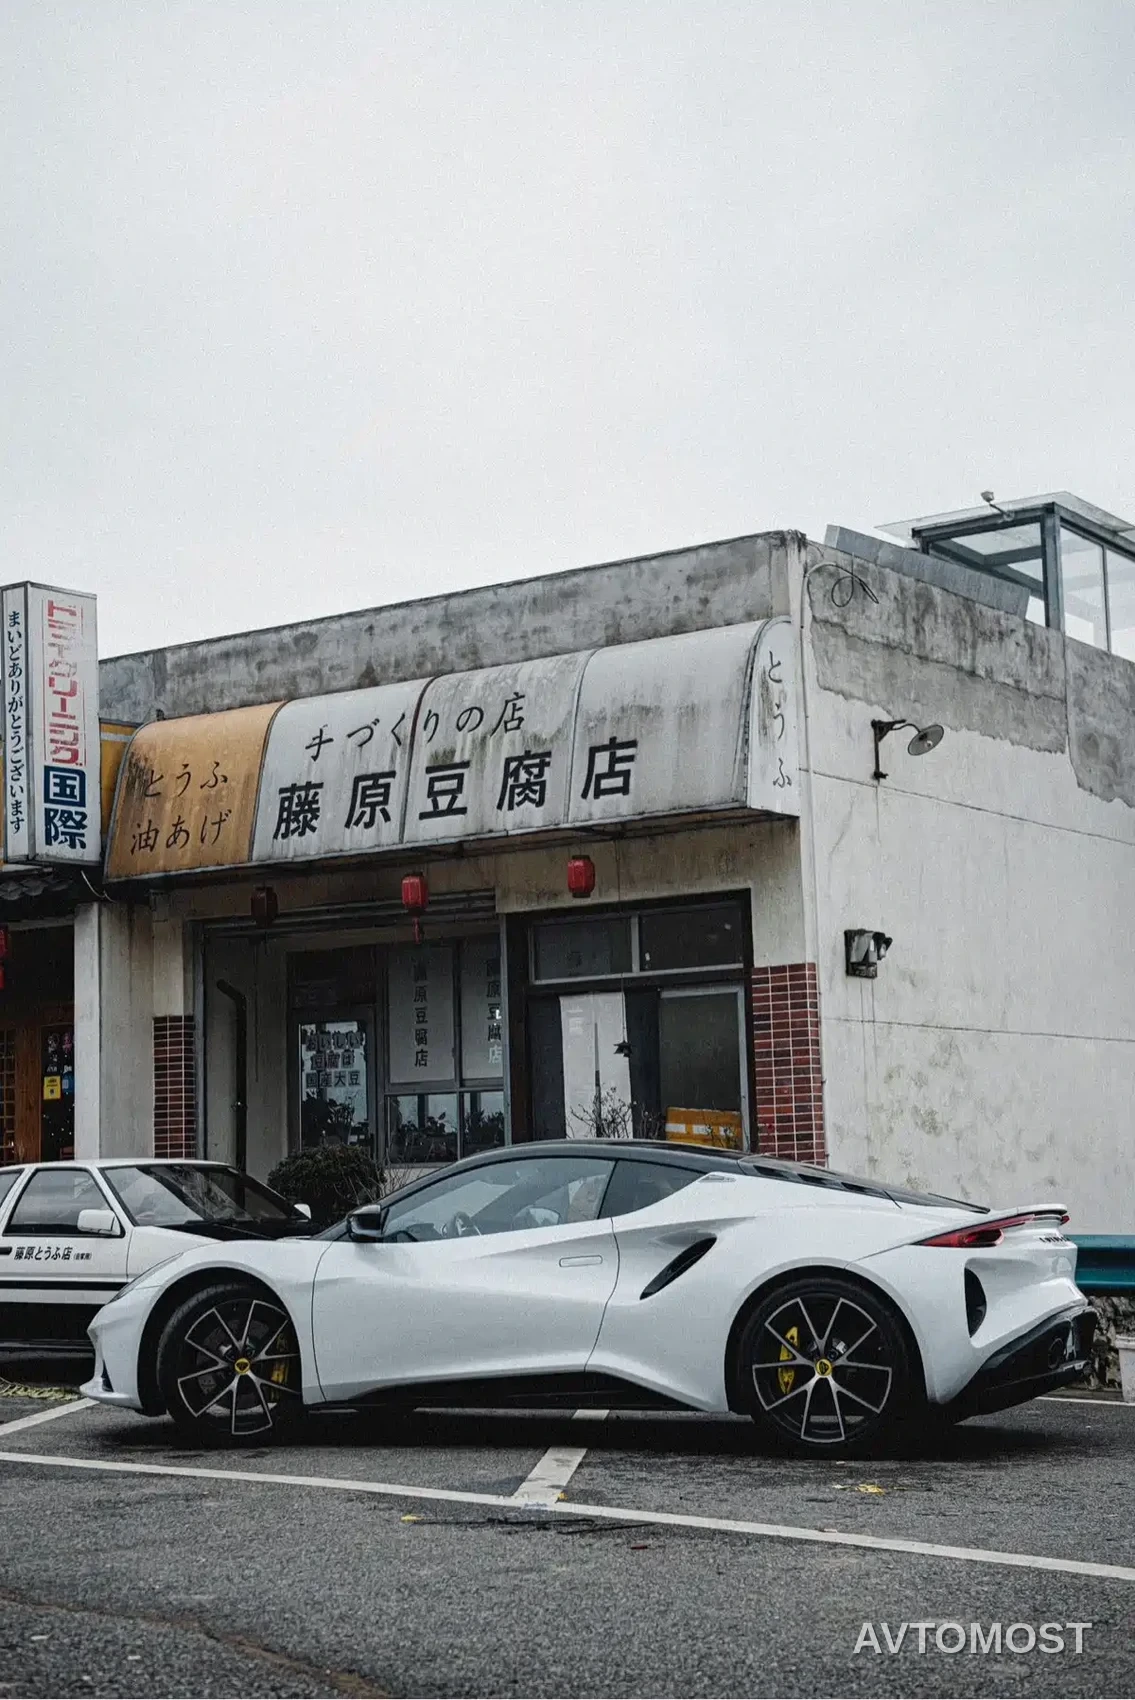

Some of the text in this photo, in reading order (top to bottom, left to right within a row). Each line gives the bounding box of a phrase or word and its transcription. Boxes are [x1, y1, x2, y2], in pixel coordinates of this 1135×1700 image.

[7, 610, 26, 835] まいどありがとうございます
[305, 691, 525, 762] 手づくりの店
[767, 650, 792, 790] とうふ
[44, 765, 87, 850] 国際
[143, 760, 229, 798] とうふ
[273, 735, 638, 841] 藤原豆腐店
[130, 808, 232, 856] 油あげ
[485, 960, 502, 1064] 原豆腐店
[14, 1246, 72, 1260] 藤原とうふ店
